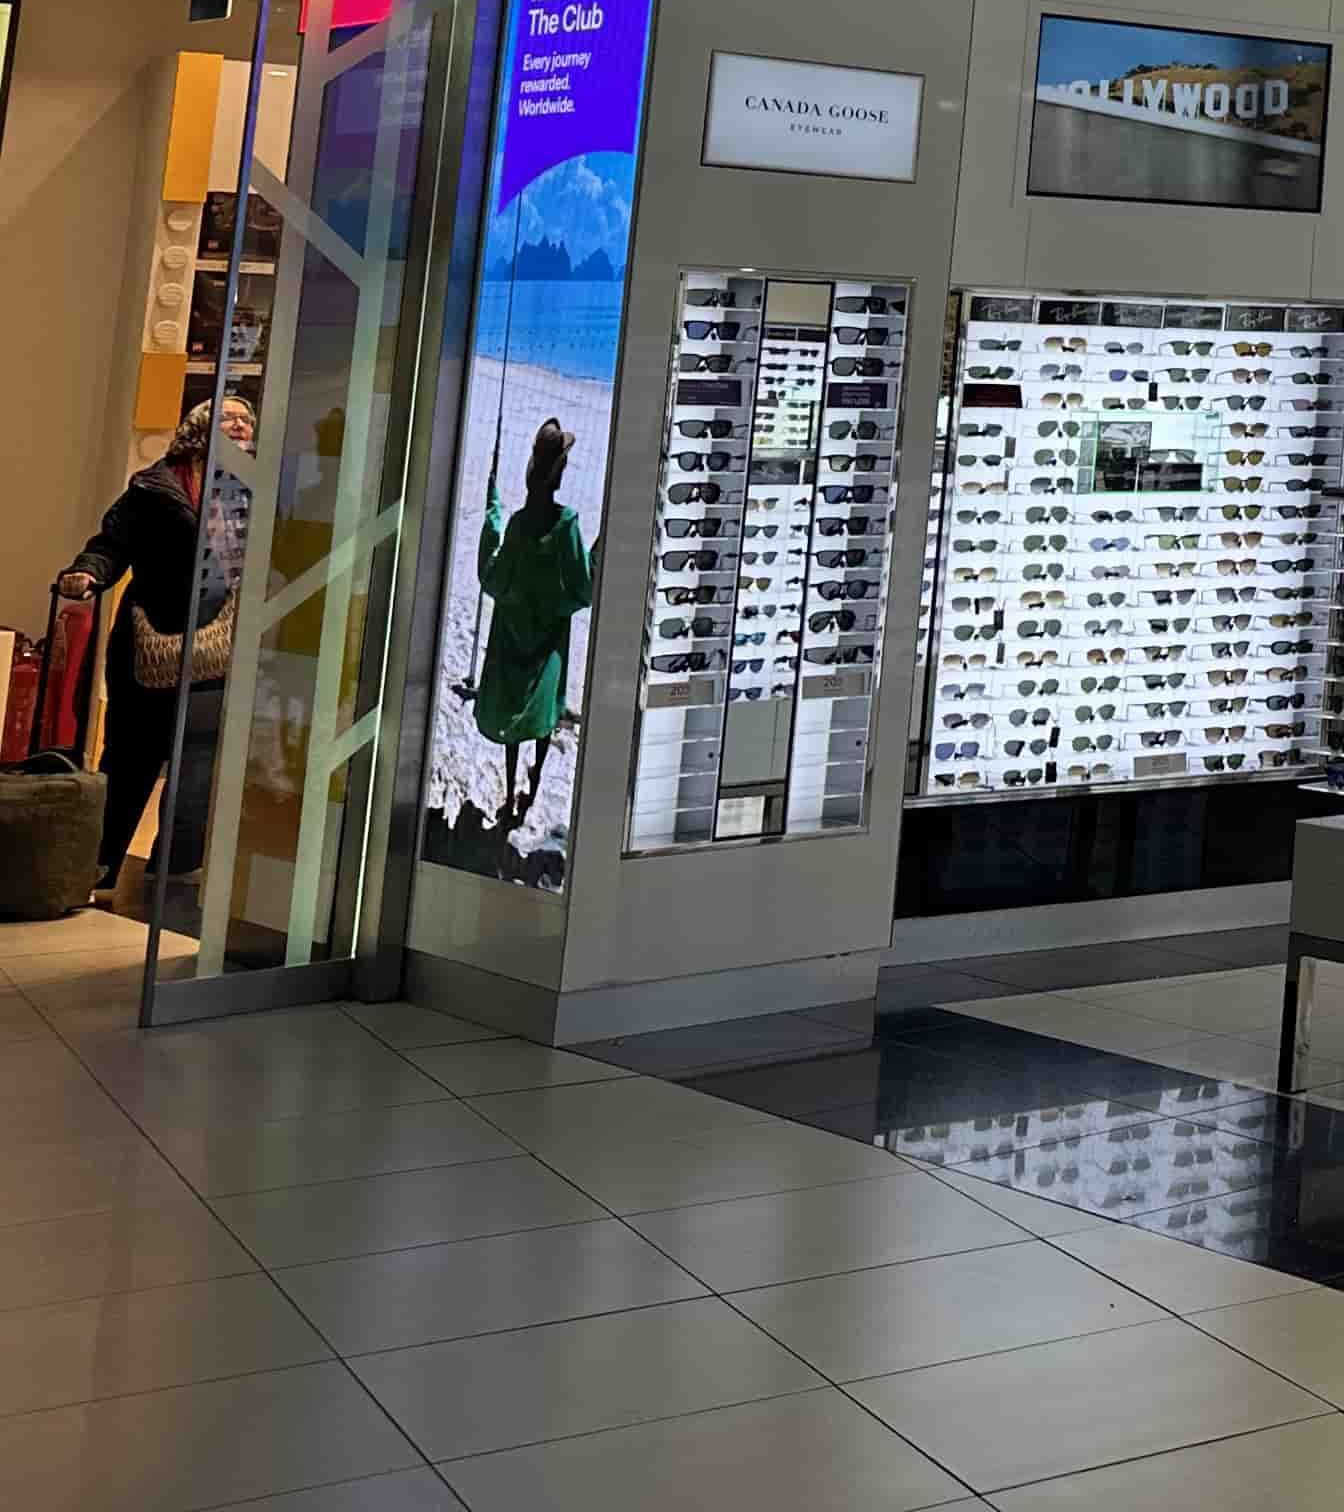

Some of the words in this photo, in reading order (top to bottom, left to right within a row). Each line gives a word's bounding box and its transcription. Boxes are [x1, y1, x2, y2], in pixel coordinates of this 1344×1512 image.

[528, 7, 559, 36] The
[562, 2, 603, 33] Club
[522, 53, 551, 72] Every
[550, 51, 592, 72] journey
[520, 73, 571, 94] rewarded.
[518, 96, 575, 116] Worldwide.
[744, 95, 822, 117] CANADA
[828, 104, 889, 124] GOOSE
